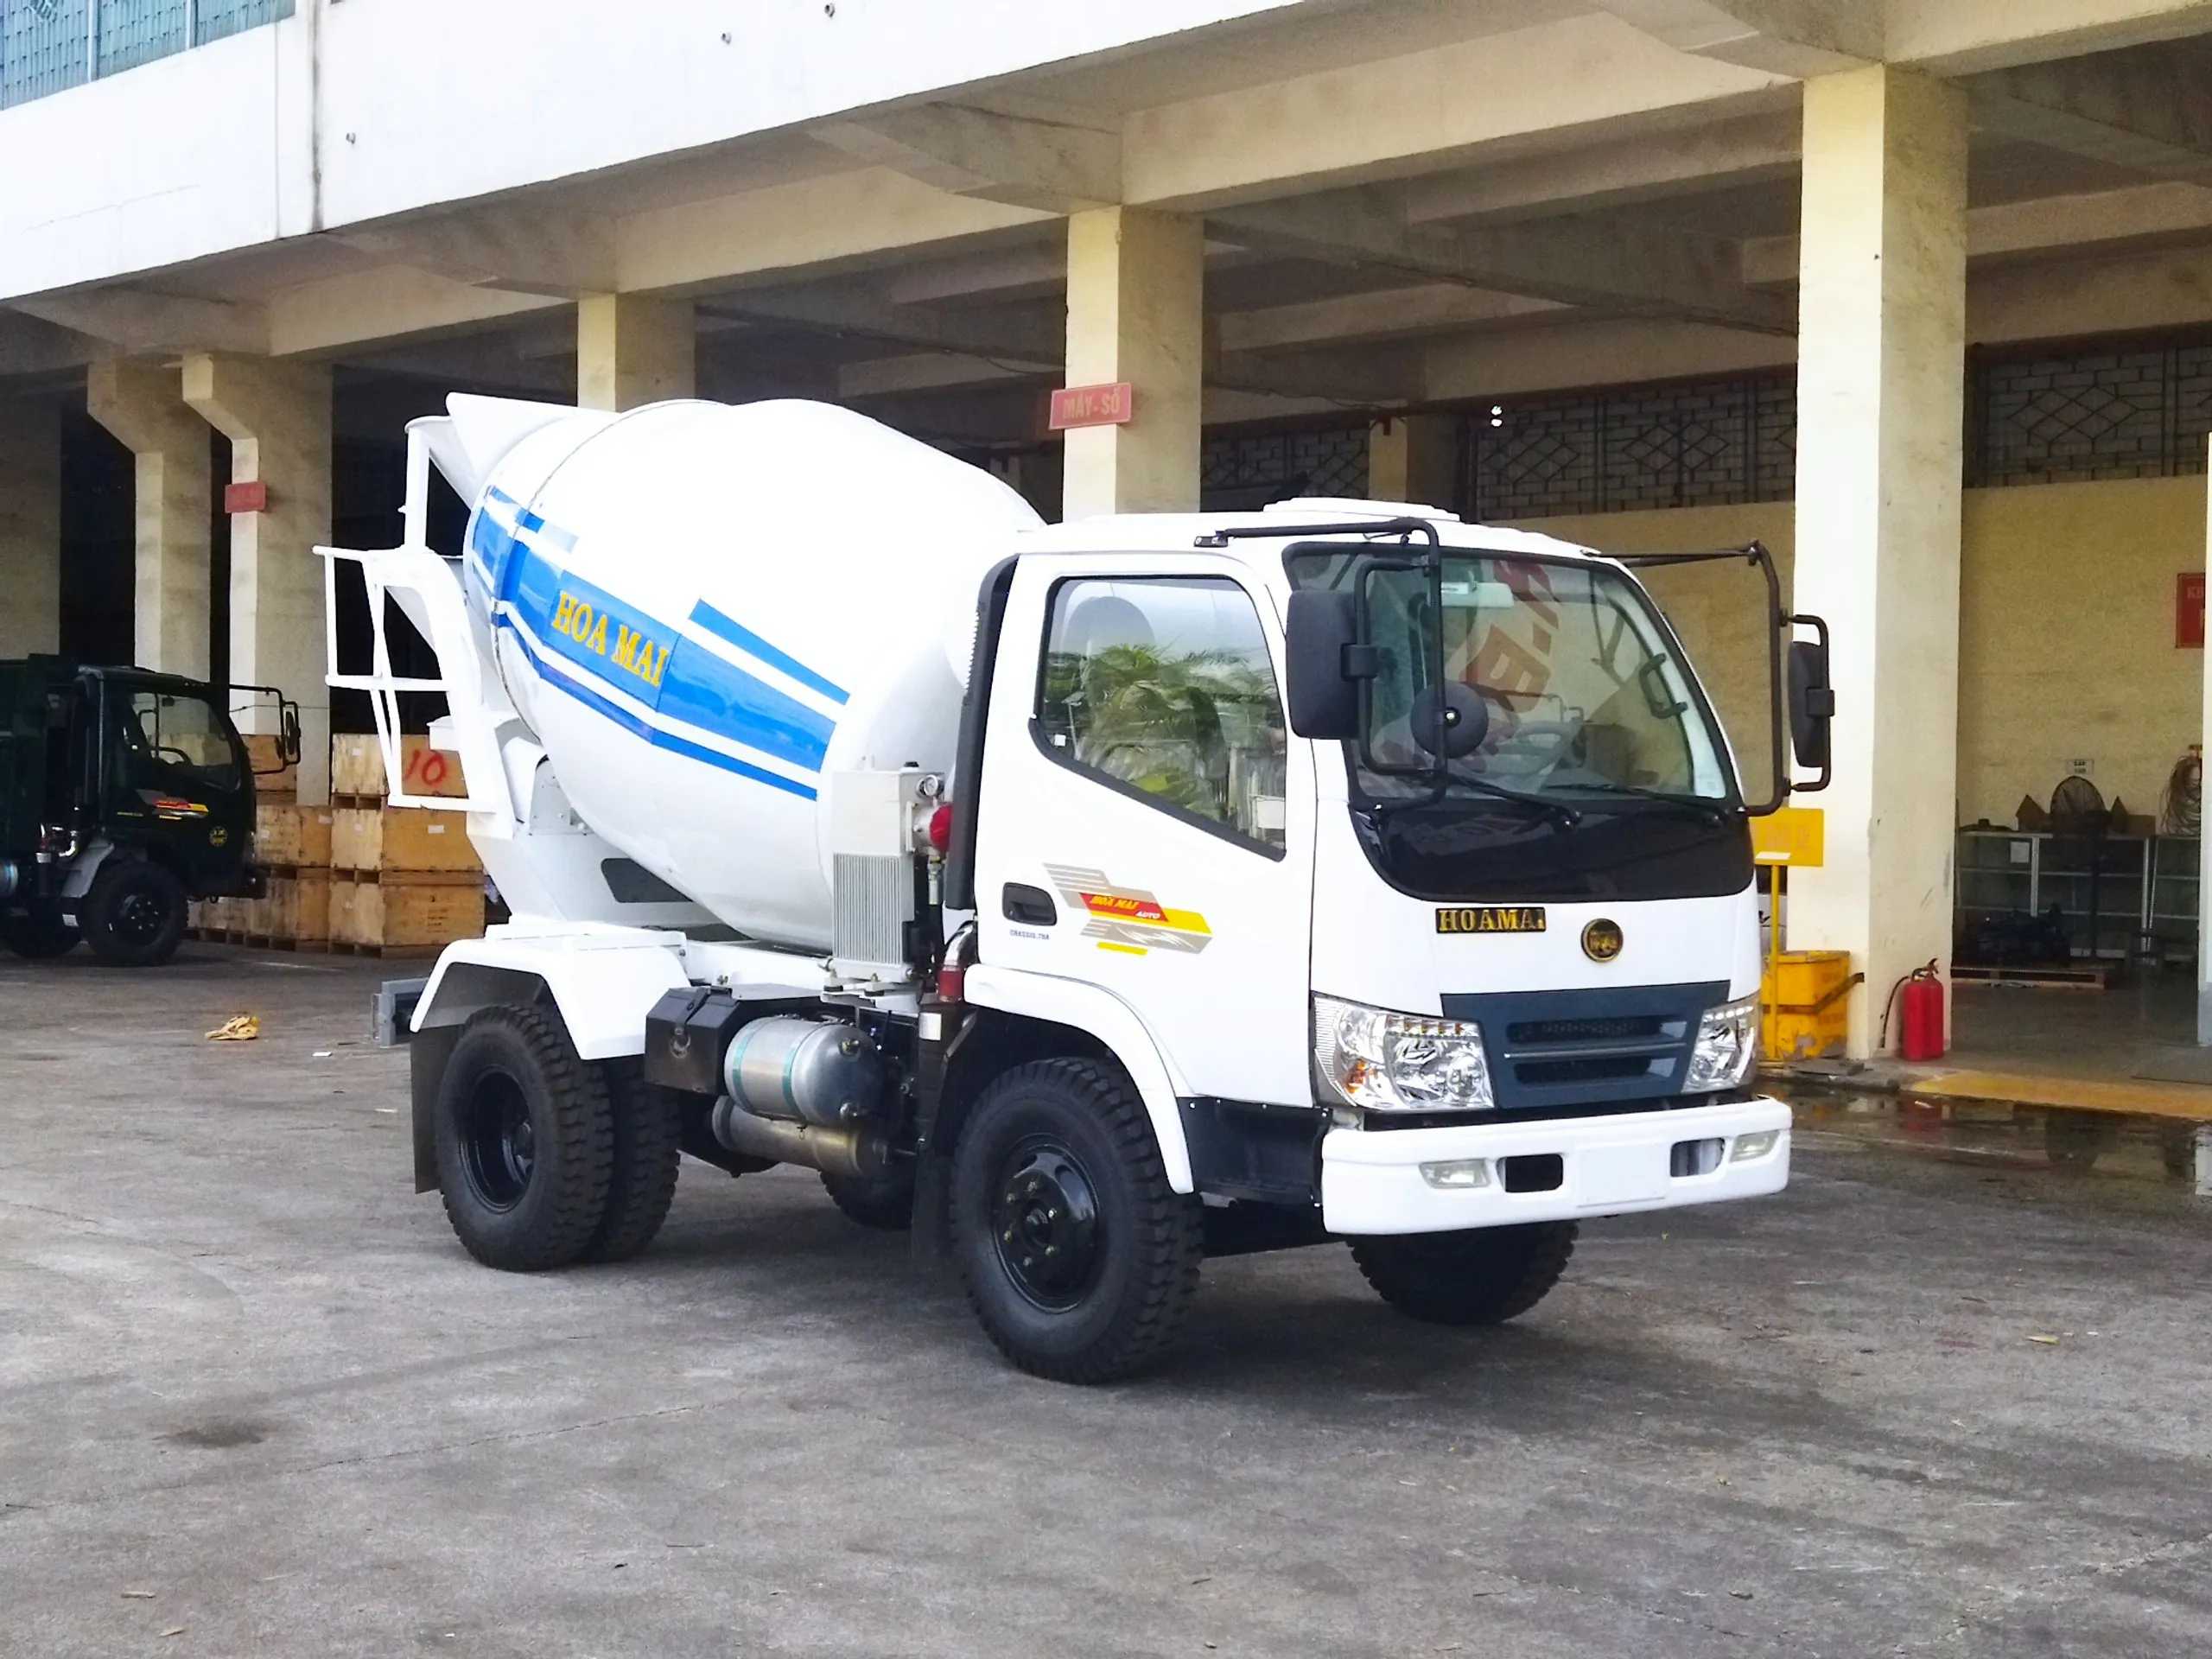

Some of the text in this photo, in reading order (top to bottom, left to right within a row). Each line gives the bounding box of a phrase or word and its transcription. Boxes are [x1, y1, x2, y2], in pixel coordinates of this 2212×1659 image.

[551, 590, 669, 687] HOA MAI
[403, 749, 447, 785] 10
[1135, 911, 1160, 919] AUTO
